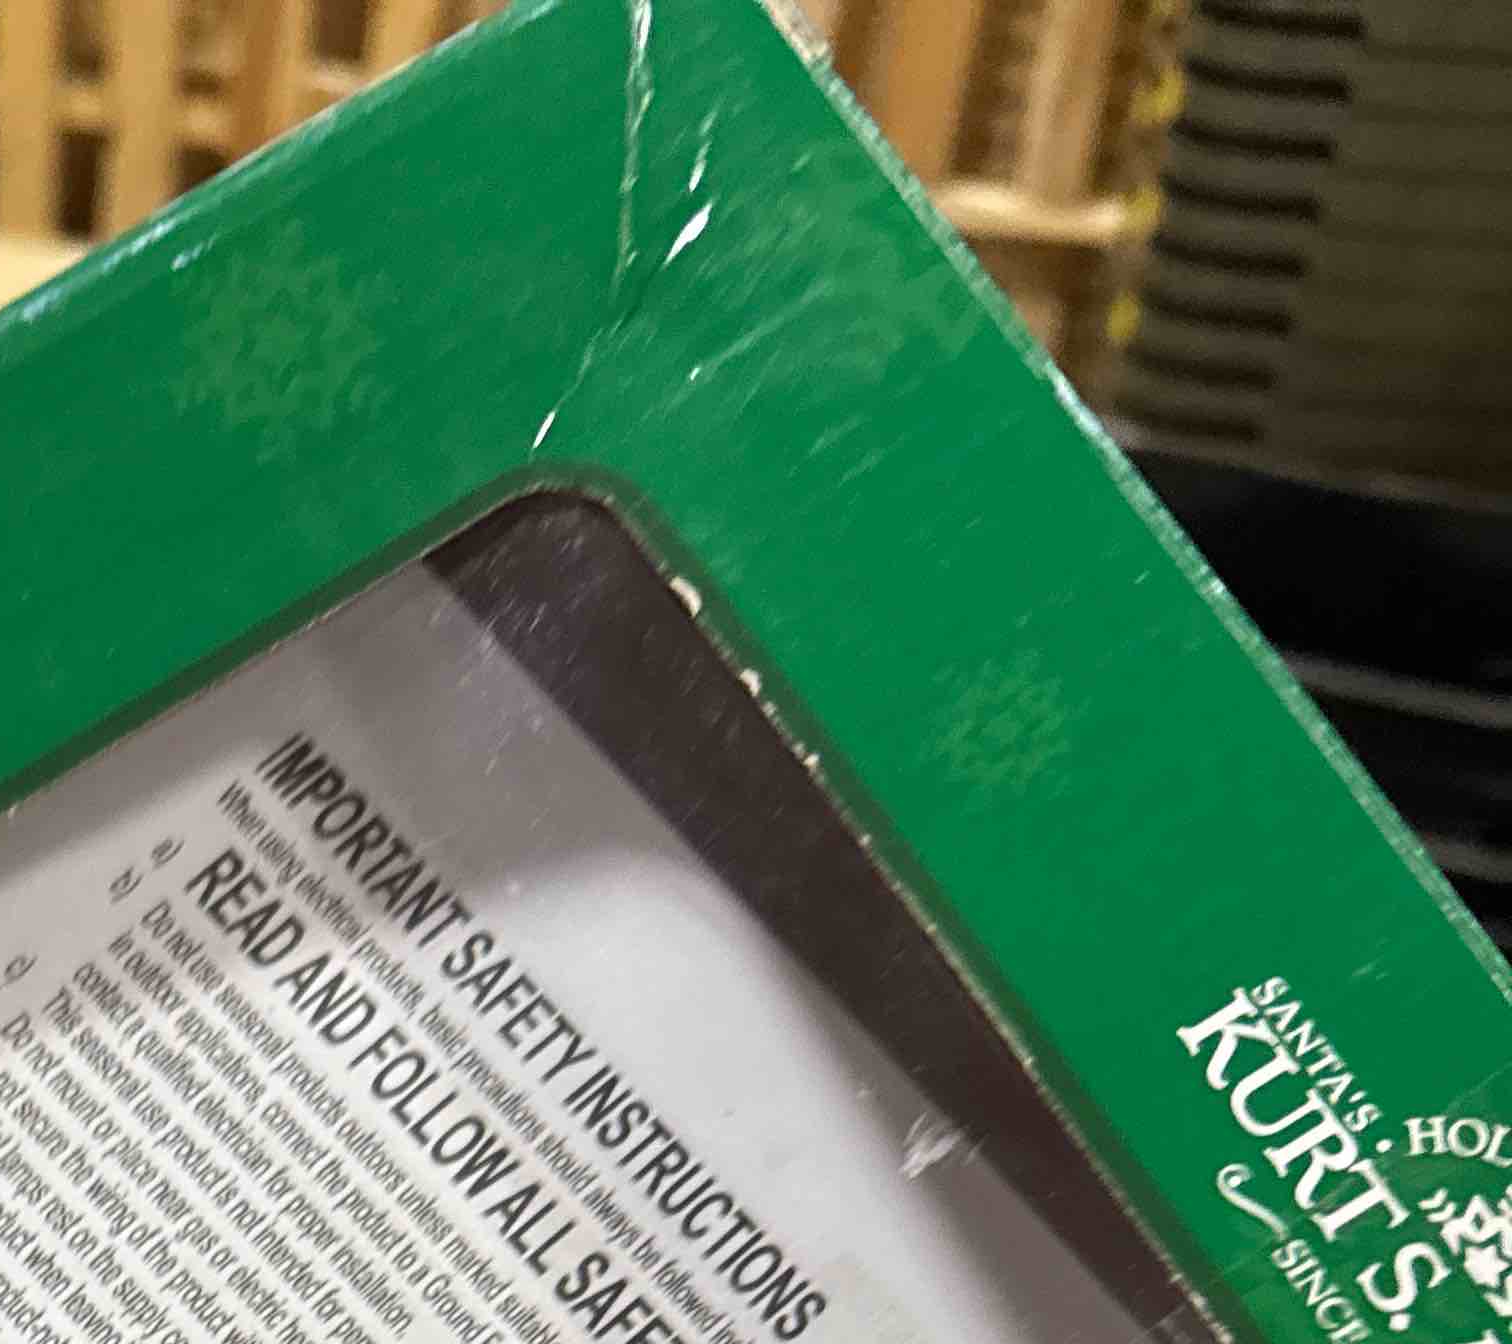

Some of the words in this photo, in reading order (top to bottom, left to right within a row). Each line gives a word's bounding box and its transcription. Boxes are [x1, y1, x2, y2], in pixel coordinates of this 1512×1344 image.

[183, 845, 308, 970] READ
[272, 946, 380, 1049] AND
[347, 1023, 523, 1202] FOLLOW
[482, 1176, 581, 1277] ALL
[254, 727, 470, 950] IMPORTANT
[438, 927, 597, 1087] SAFETY
[561, 1062, 829, 1344] INSTRUCTIONS
[1175, 986, 1410, 1241] KURT
[1251, 976, 1381, 1133] SANTA'S
[20, 1242, 75, 1299] when
